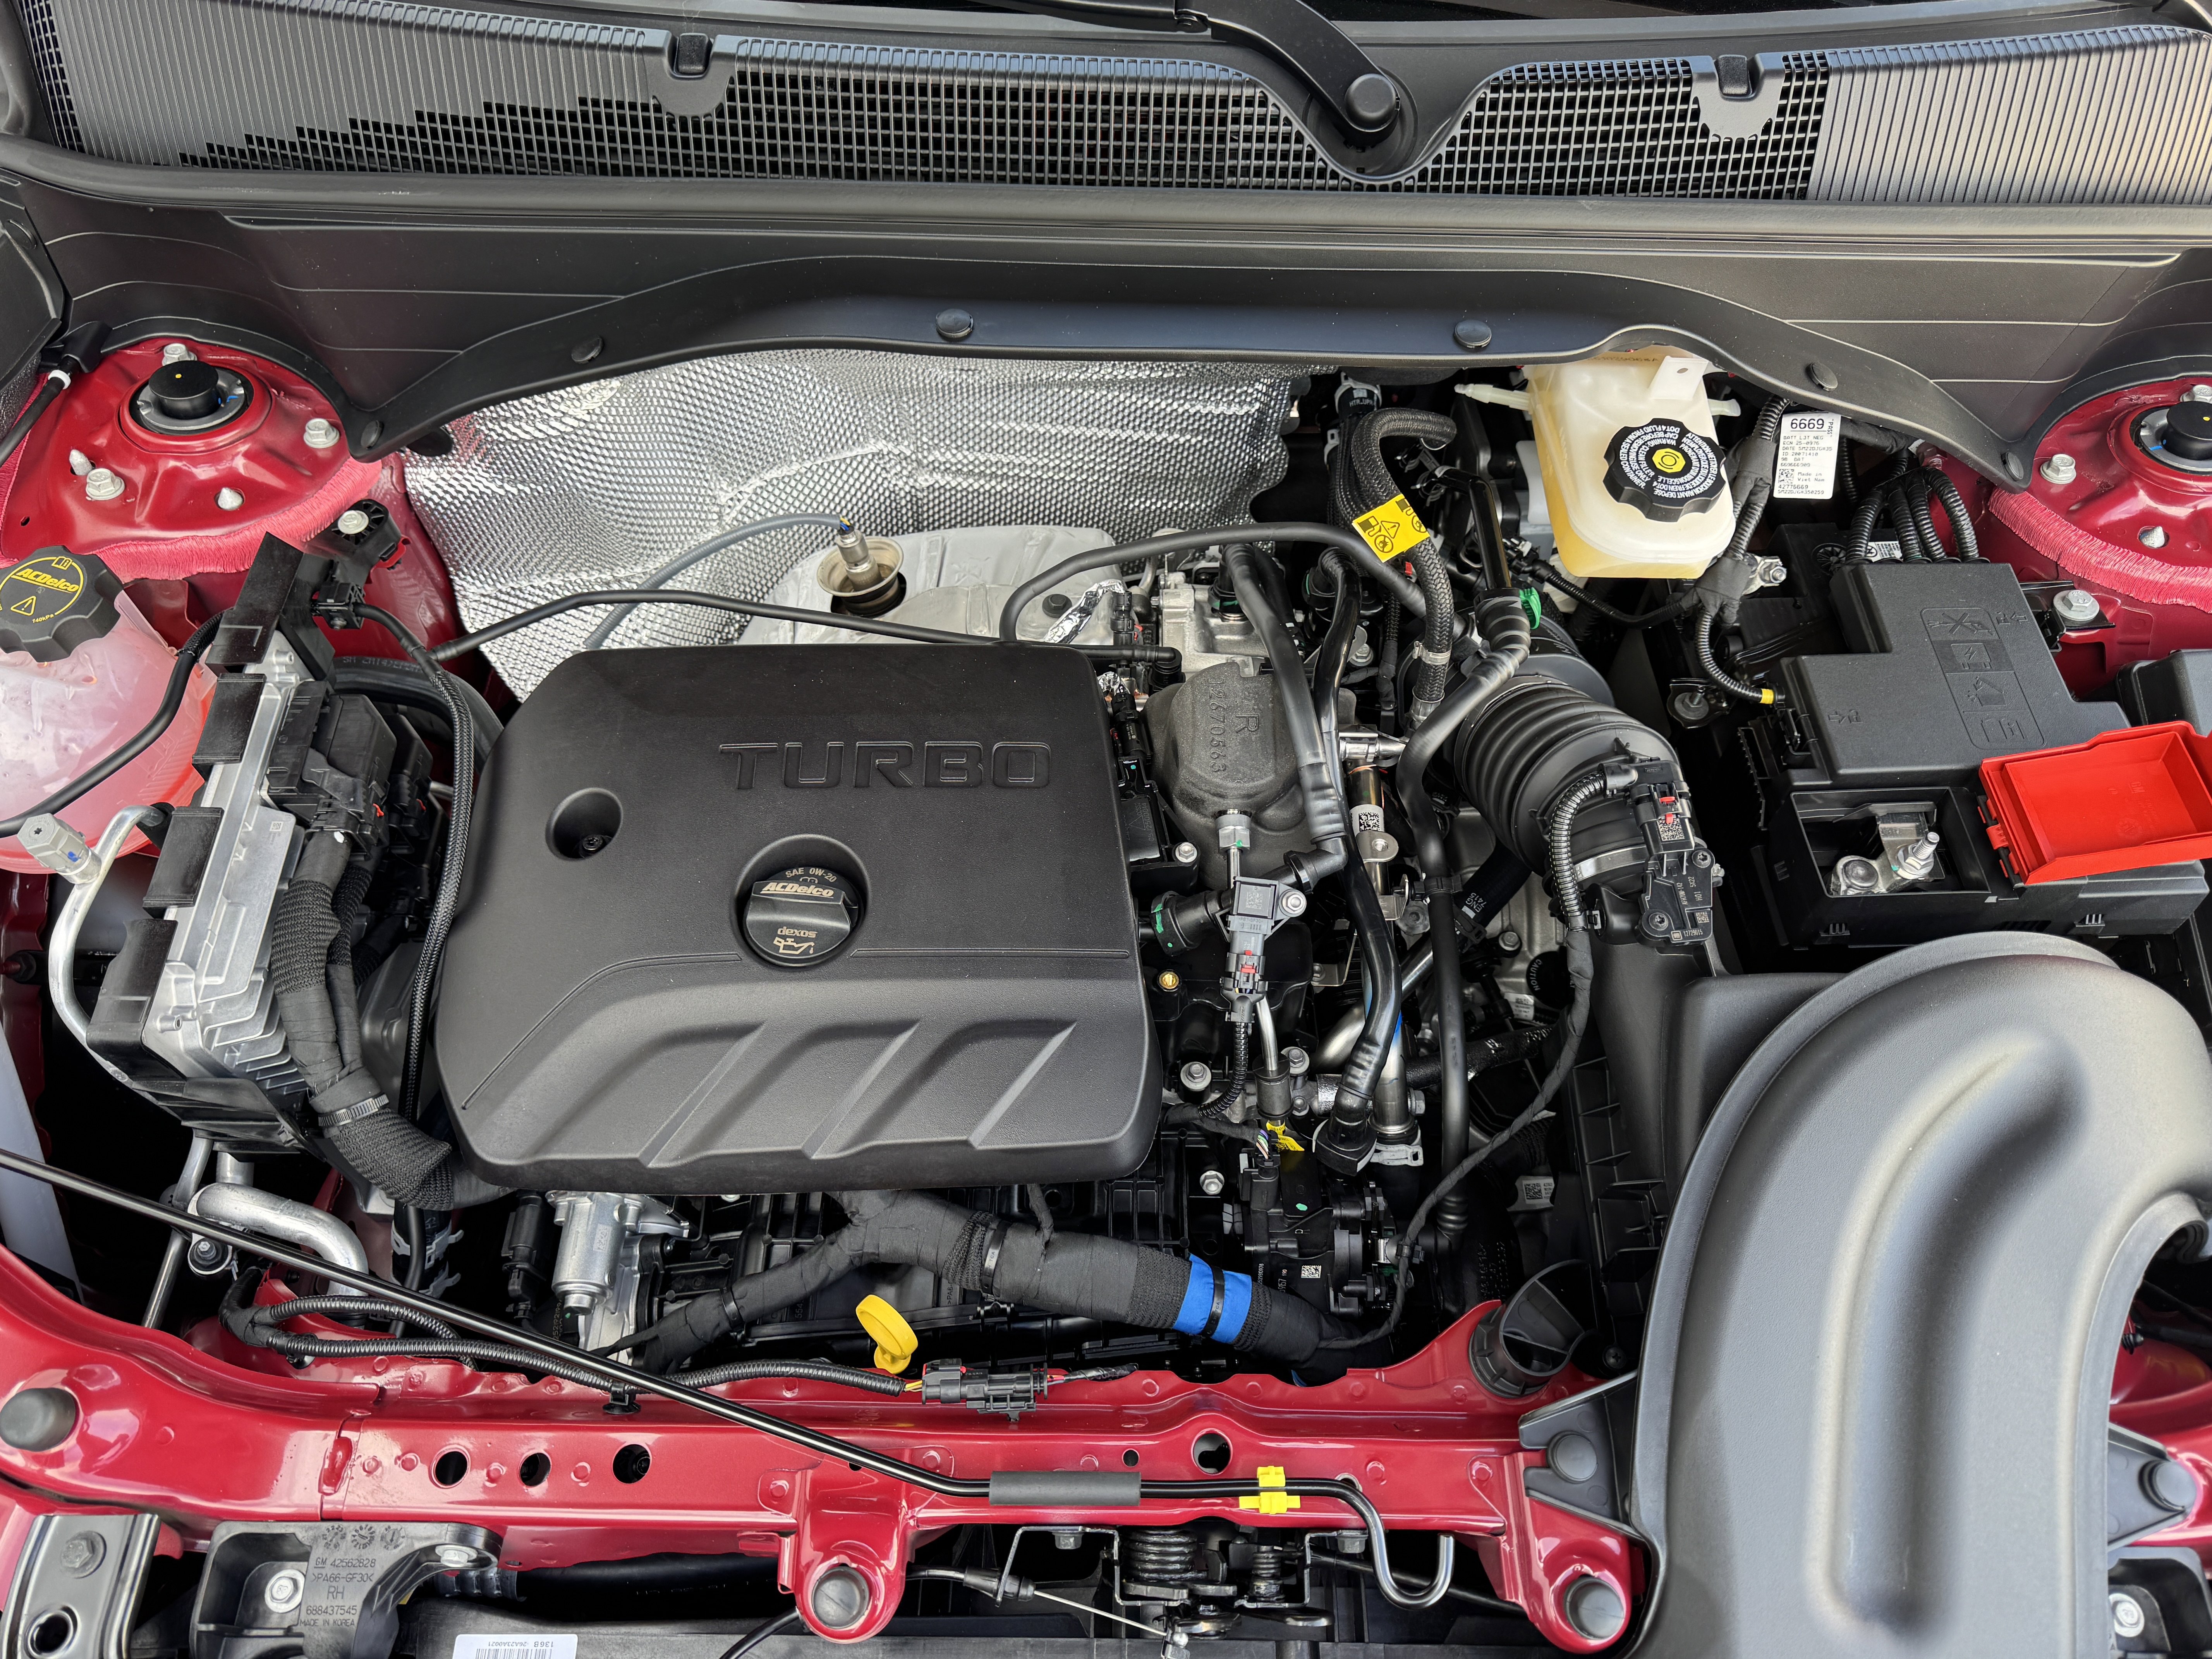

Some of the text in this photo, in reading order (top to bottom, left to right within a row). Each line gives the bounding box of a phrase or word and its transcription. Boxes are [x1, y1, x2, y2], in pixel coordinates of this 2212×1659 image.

[1643, 425, 1662, 433] FLUID
[1791, 418, 1824, 429] 6669
[1627, 429, 1645, 441] FROM
[1640, 431, 1664, 441] BEFORE
[1620, 441, 1630, 460] SEALED
[1638, 445, 1649, 460] CLEAN
[1679, 443, 1700, 467] PROVENANT
[1628, 460, 1640, 471] USE
[1638, 461, 1655, 477] FILLER
[1700, 460, 1709, 469] QUE
[1706, 452, 1718, 474] NETTOYER
[1633, 470, 1651, 482] ONLY
[1678, 473, 1694, 484] BIDON
[1688, 473, 1706, 488] LIQUIDE
[1677, 489, 1695, 498] AVANT
[1692, 478, 1714, 495] BOUCHON
[16, 568, 79, 592] ACDelco
[32, 613, 54, 623] 140kPa
[1235, 714, 1259, 733] R
[719, 741, 1051, 789] TURBO
[785, 867, 837, 883] SAE 0W-20
[762, 882, 834, 896] ACDelco
[1465, 898, 1482, 912] ENG
[1469, 892, 1487, 908] 7415
[777, 926, 818, 938] dexos
[1530, 959, 1543, 991] CAUTION
[314, 1557, 376, 1568] GM 42562828
[311, 1573, 374, 1582] >PA66-GF30<
[327, 1585, 345, 1599] RH
[306, 1605, 357, 1615] 688437545
[333, 1618, 355, 1626] KOREA
